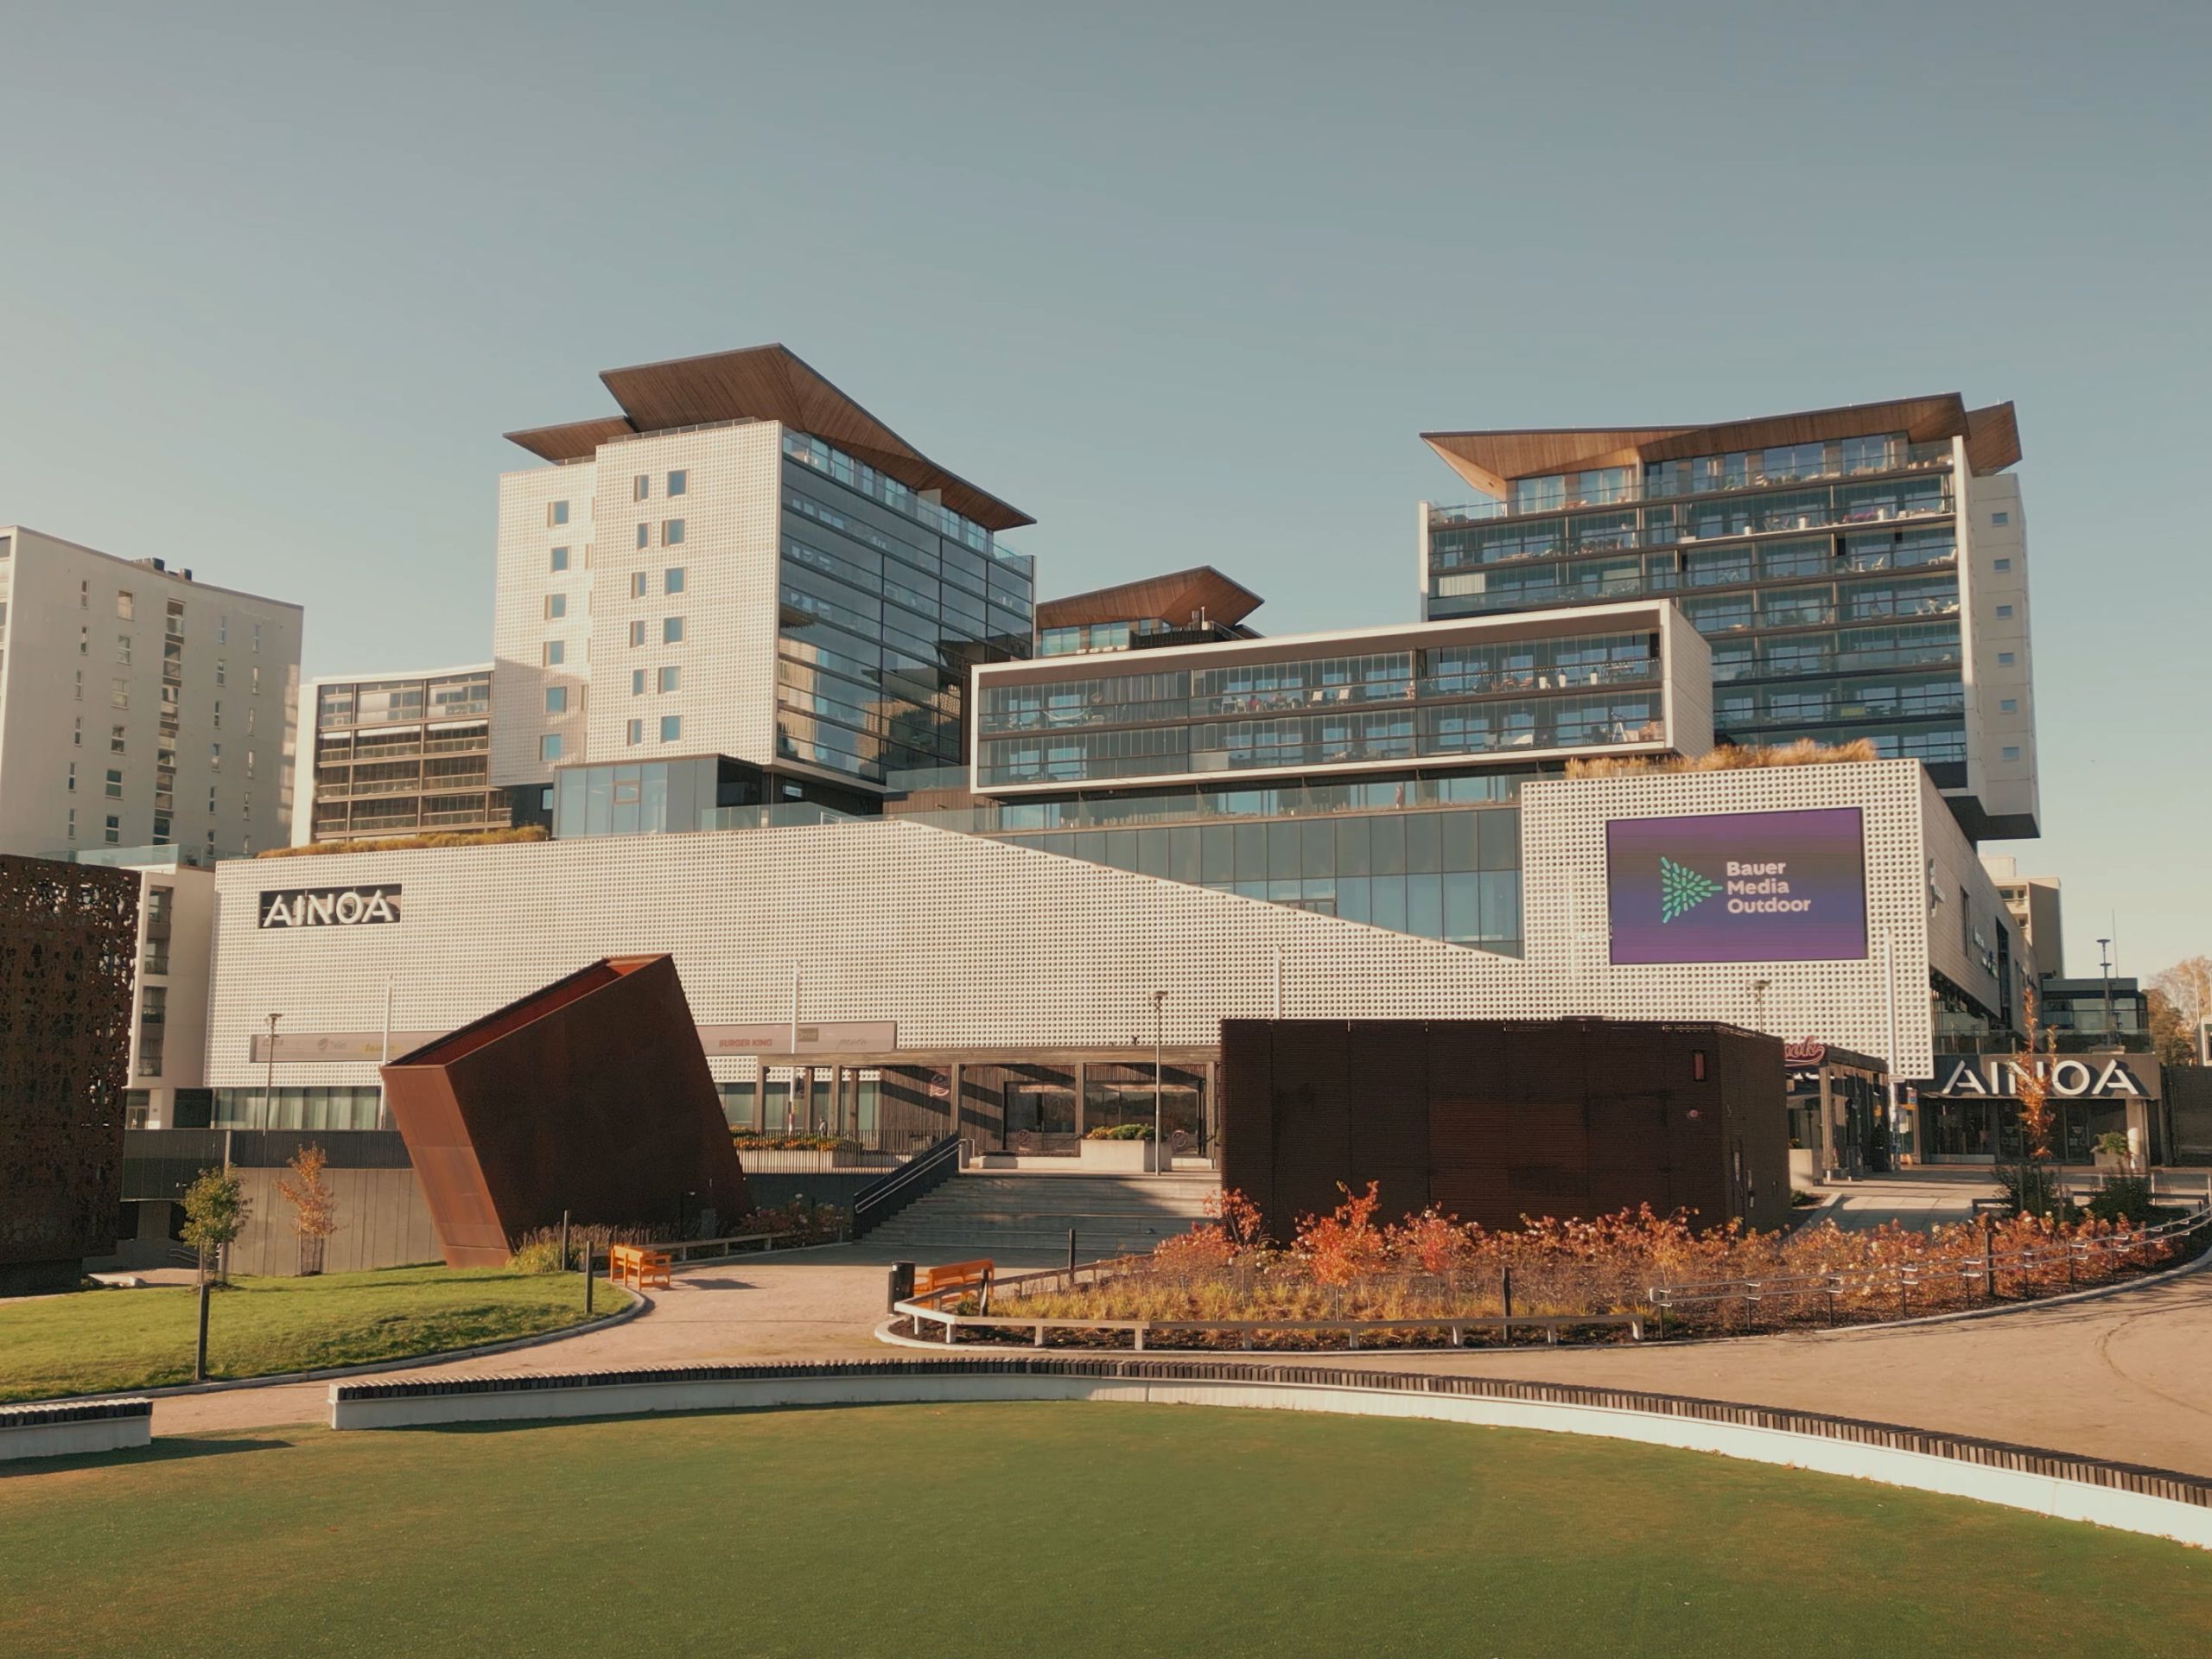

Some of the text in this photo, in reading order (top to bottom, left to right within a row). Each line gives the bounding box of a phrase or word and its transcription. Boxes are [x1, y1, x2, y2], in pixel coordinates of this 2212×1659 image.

[1726, 861, 1786, 876] Bauer
[1727, 878, 1789, 895] Media
[263, 888, 394, 928] AINOA
[1727, 897, 1811, 913] Outdoor
[719, 1038, 772, 1047] BURGER KING
[1942, 1059, 2139, 1095] AINOA
